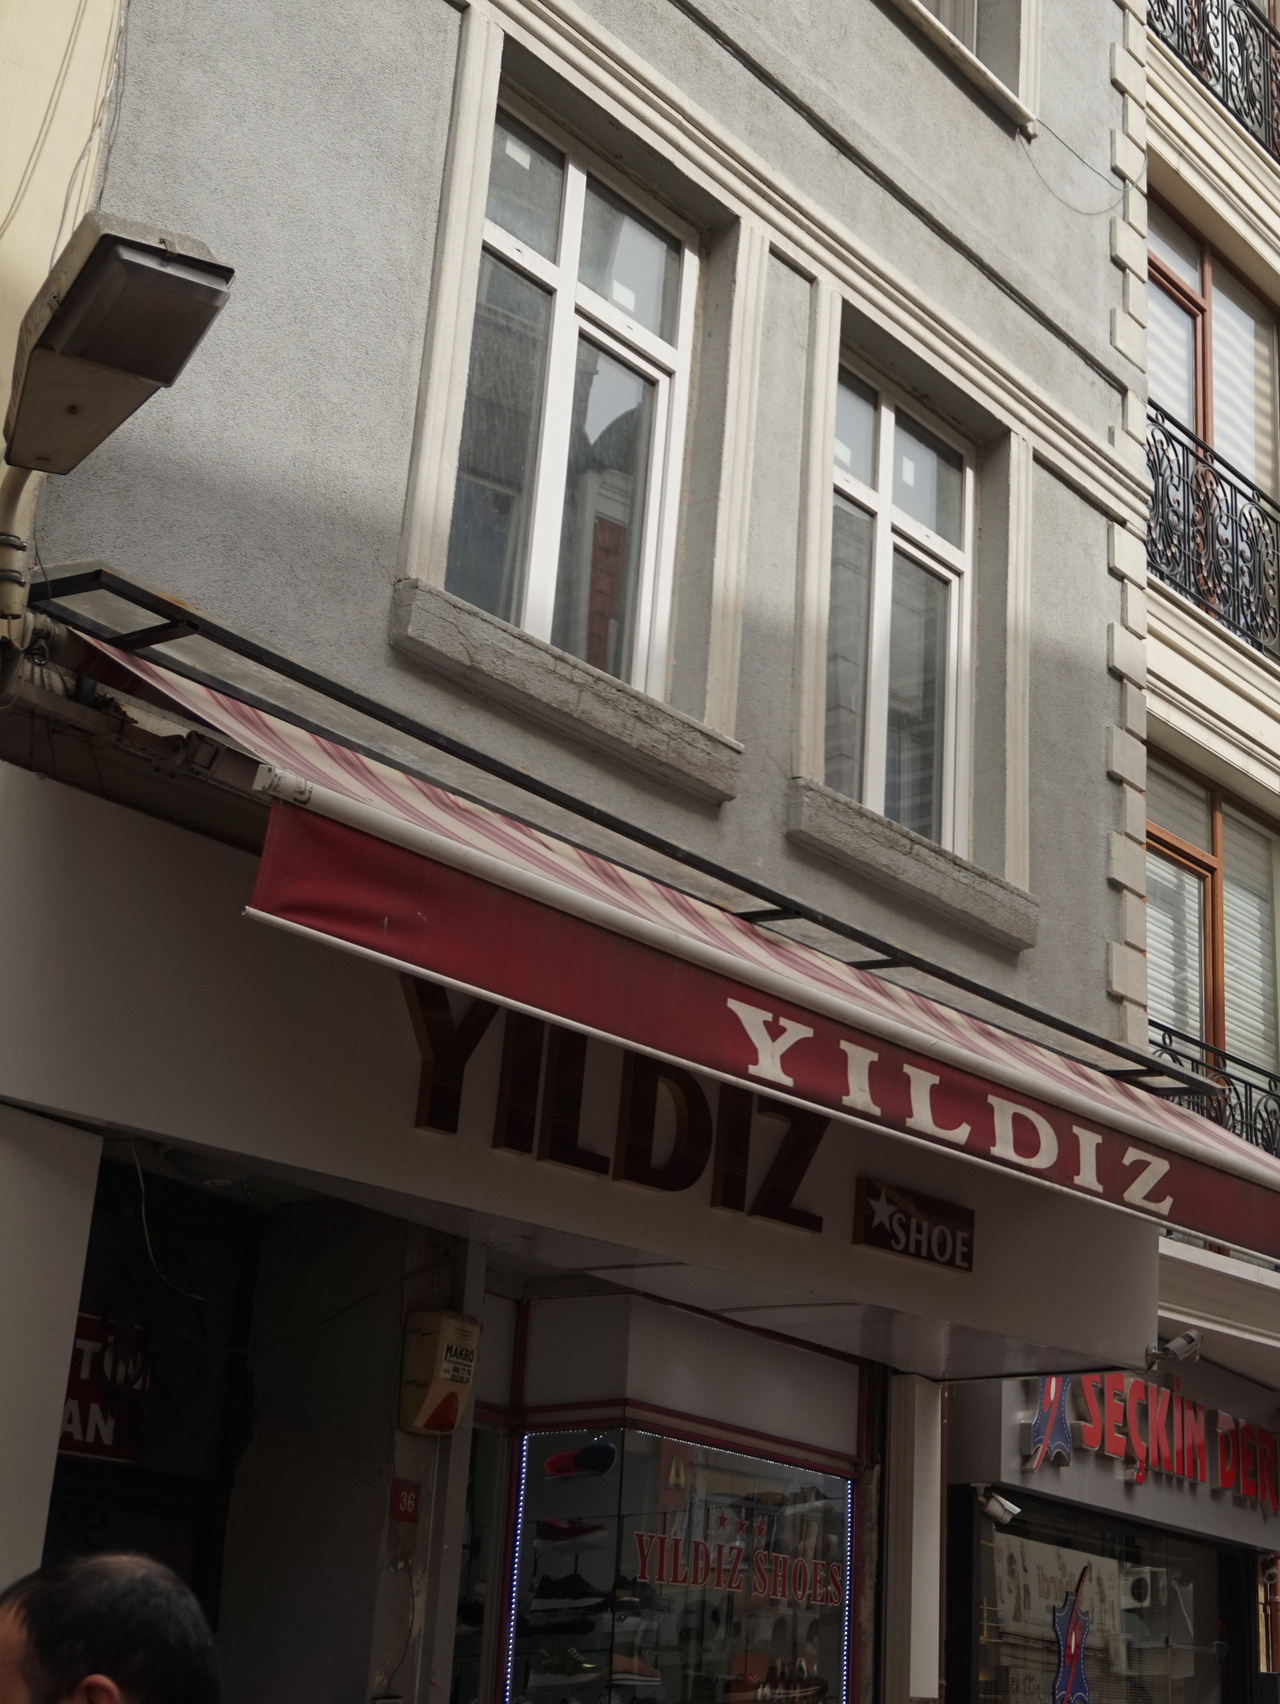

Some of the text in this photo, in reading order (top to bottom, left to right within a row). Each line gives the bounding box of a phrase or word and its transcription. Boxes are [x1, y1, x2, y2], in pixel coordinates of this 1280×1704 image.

[400, 973, 832, 1233] YILDIZ
[726, 998, 1174, 1216] YILDIZ
[891, 1209, 970, 1268] SHOE
[444, 1344, 475, 1363] MAKRO
[1080, 1372, 1207, 1485] SEÇKİN
[399, 1491, 415, 1512] 36
[634, 1531, 844, 1607] YILDIZ SHOES
